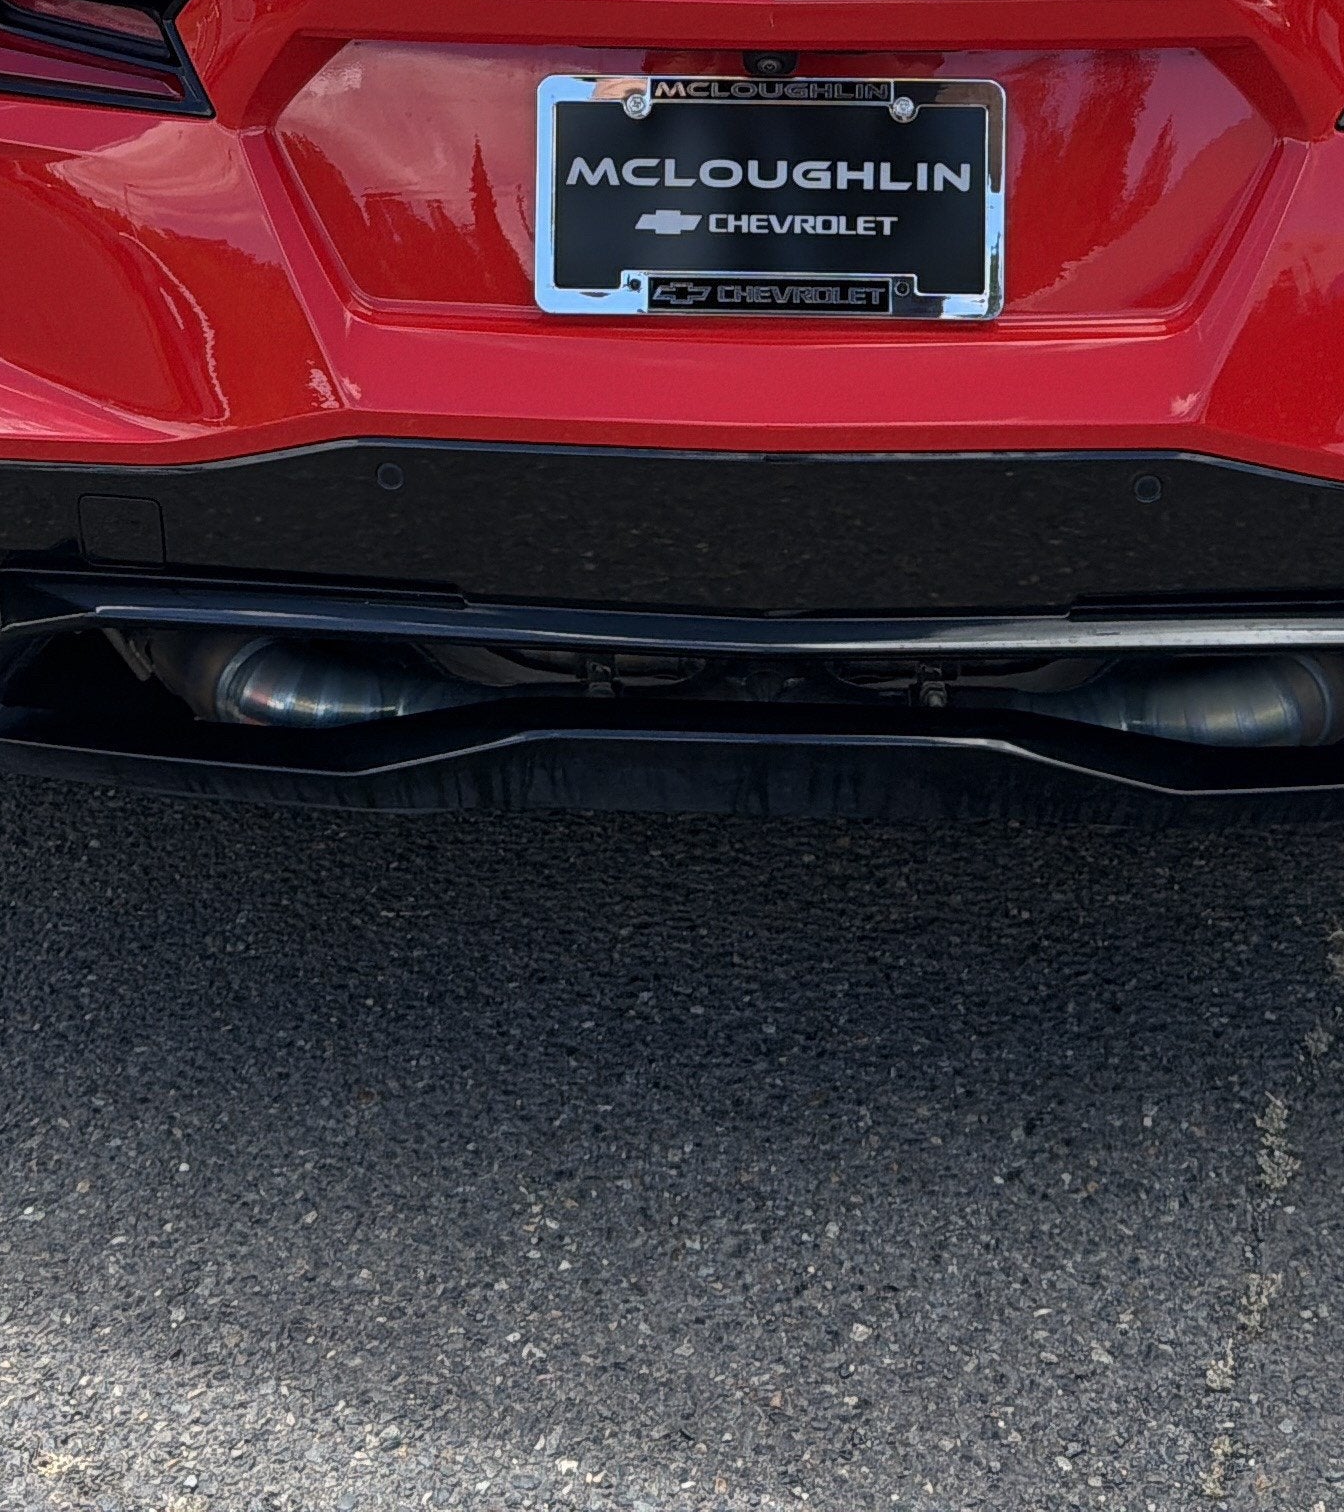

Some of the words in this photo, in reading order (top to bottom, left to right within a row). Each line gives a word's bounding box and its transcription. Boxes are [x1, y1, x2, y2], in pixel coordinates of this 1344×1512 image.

[653, 80, 890, 100] MCLOUGHLIN
[565, 156, 971, 192] MCLOUGHLIN
[708, 213, 898, 236] CHEVROLET
[716, 284, 887, 305] CHEVROLET
